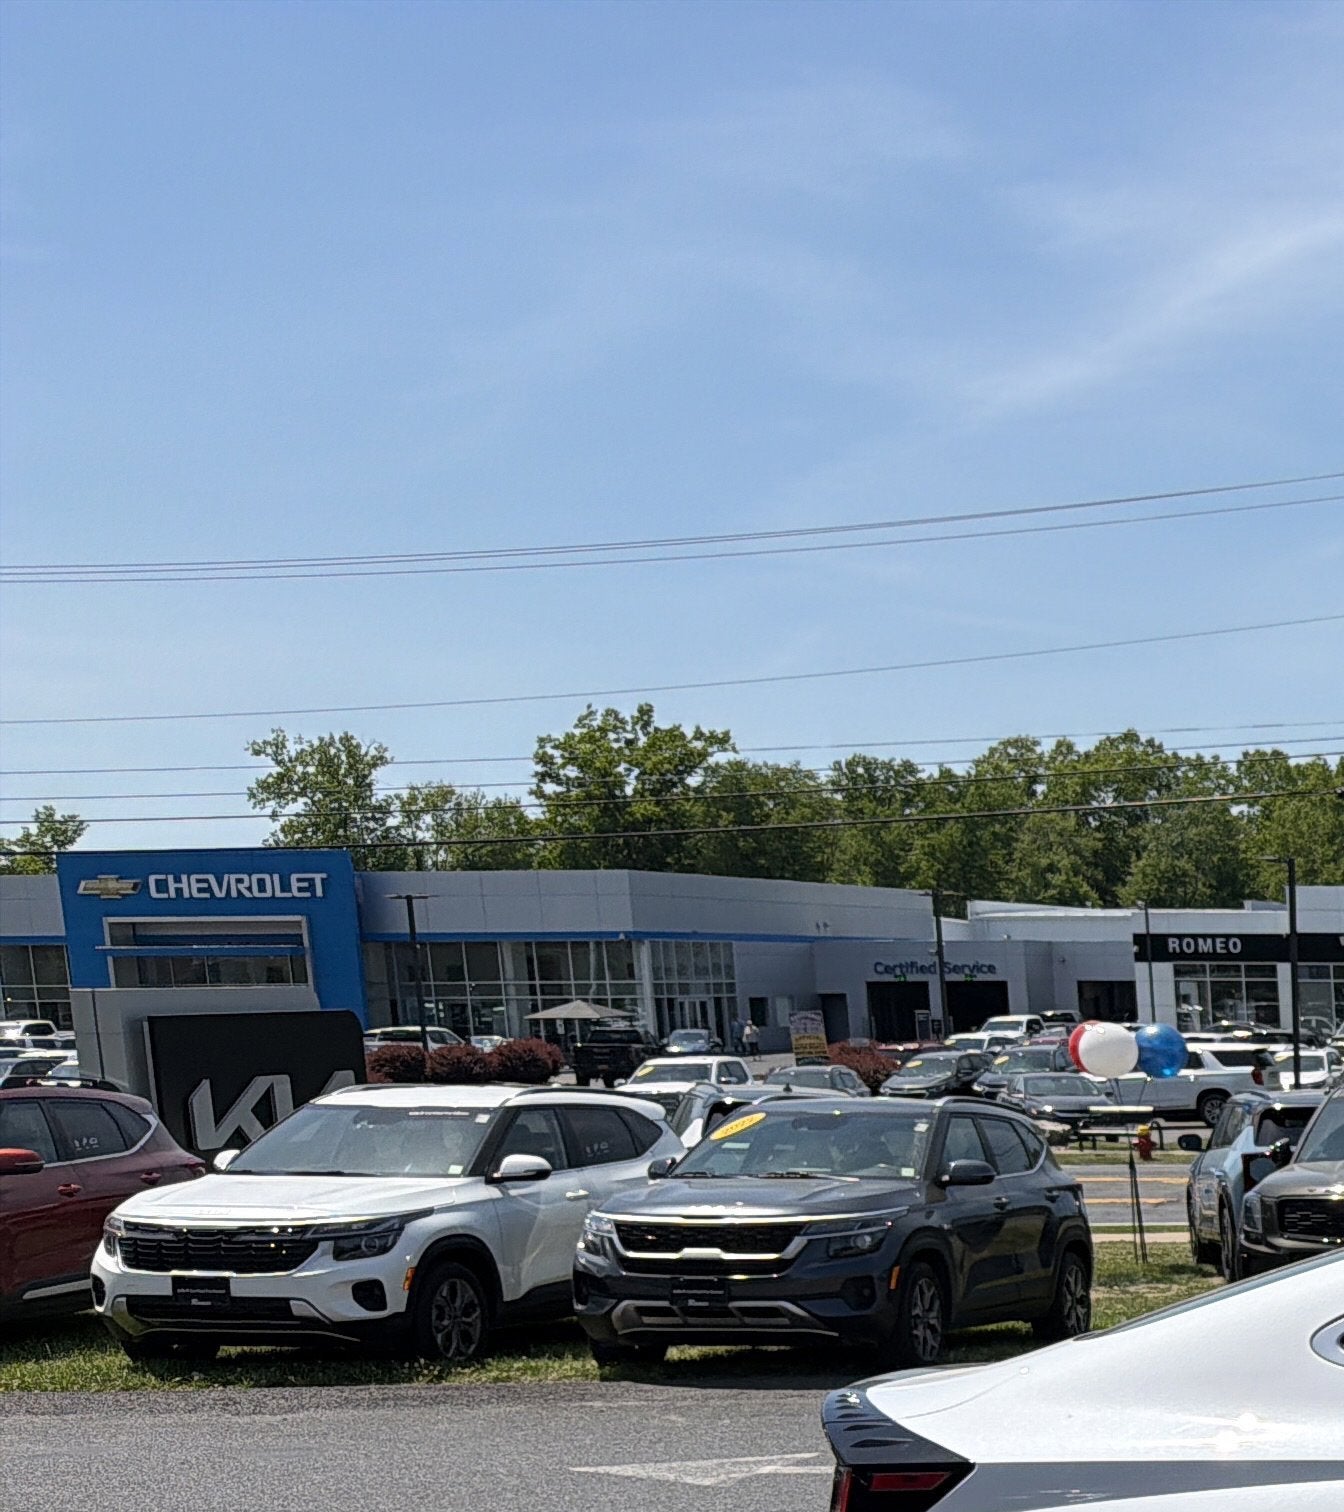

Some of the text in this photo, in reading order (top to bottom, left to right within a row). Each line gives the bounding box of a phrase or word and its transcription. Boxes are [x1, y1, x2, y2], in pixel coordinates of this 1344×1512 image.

[148, 872, 328, 899] CHEVROLET
[1167, 936, 1243, 954] ROMEO
[873, 960, 997, 976] Certified Service
[188, 1069, 356, 1151] KI
